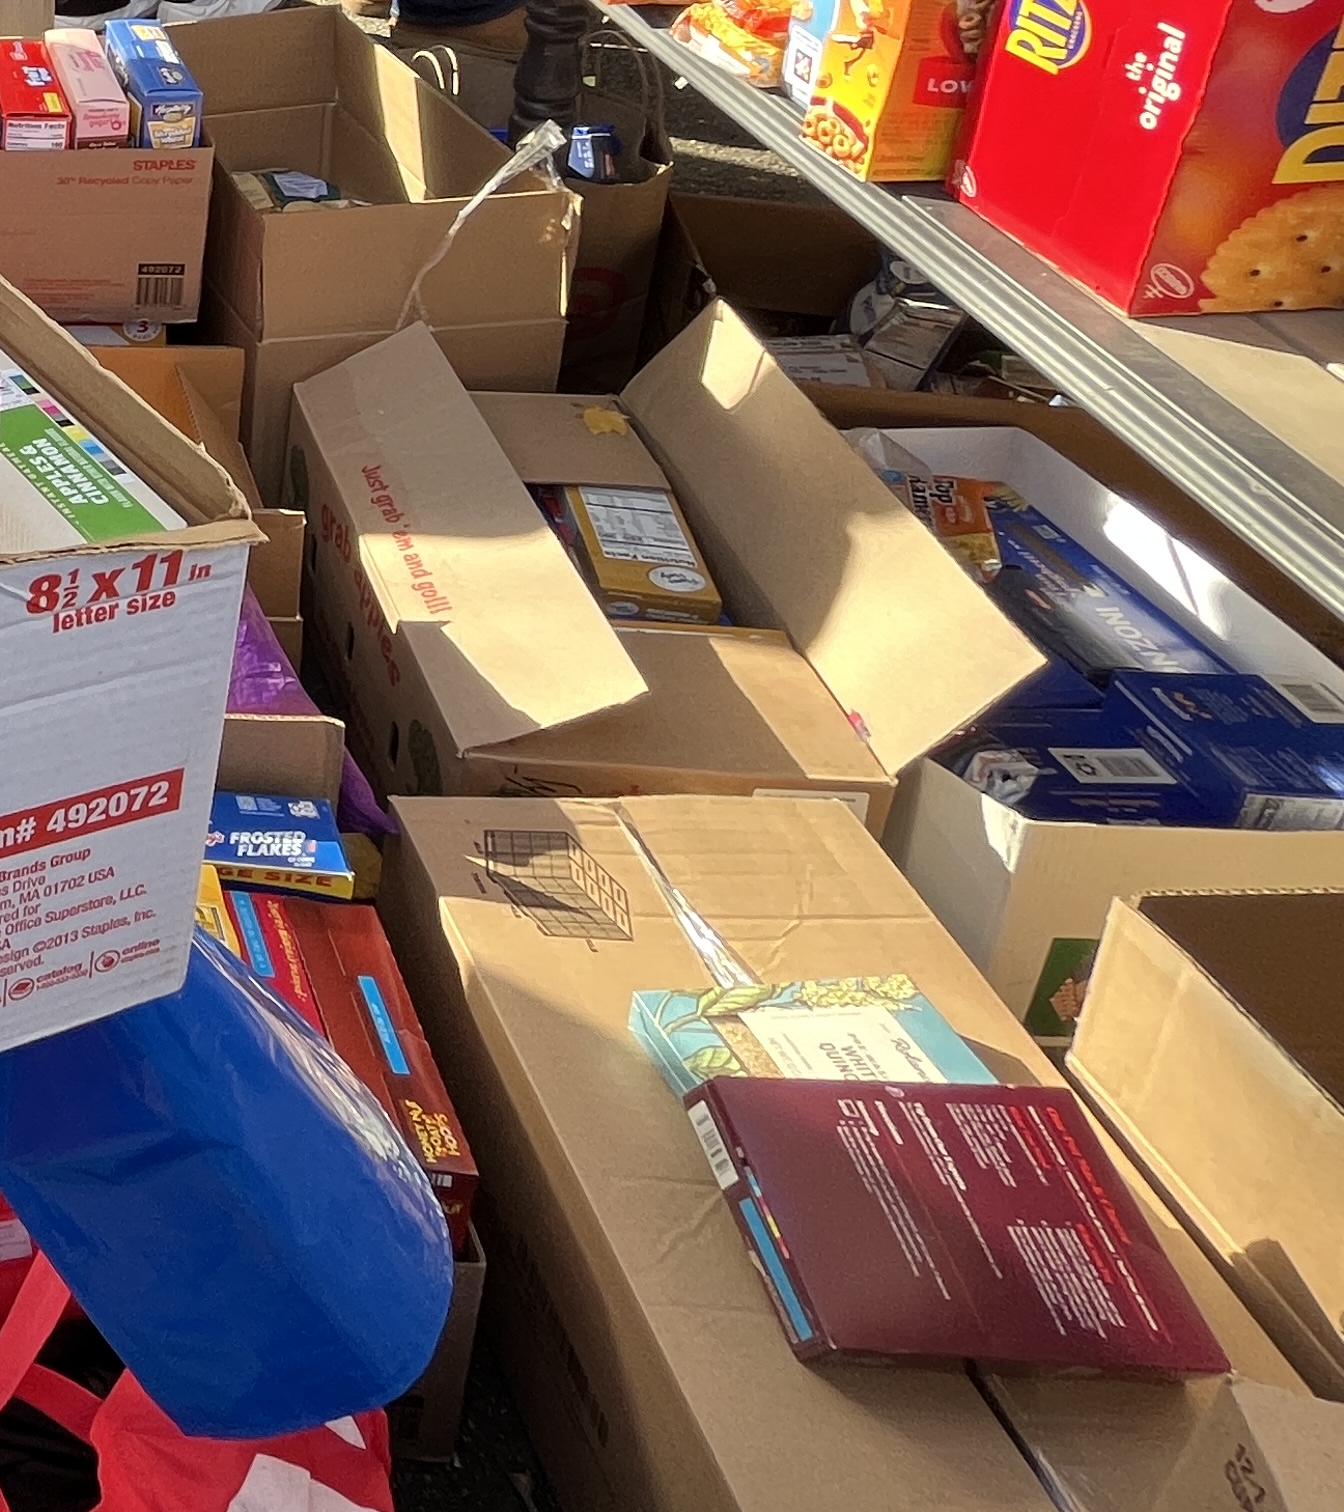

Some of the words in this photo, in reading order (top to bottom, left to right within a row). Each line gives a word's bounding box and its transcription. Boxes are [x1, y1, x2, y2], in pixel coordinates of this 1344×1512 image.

[1125, 52, 1148, 81] the
[1140, 22, 1187, 130] original
[133, 160, 196, 171] STAPLES
[30, 452, 89, 505] APPLES
[31, 437, 110, 505] CINNAMON
[362, 465, 389, 493] Just
[371, 487, 401, 524] grab
[132, 549, 183, 588] 11
[188, 563, 212, 583] in
[402, 553, 431, 579] and
[53, 600, 119, 634] letter
[127, 589, 176, 616] size
[46, 780, 170, 834] 492072
[229, 831, 307, 846] FROSTED
[237, 843, 303, 858] FLAKES
[50, 847, 91, 869] Group
[12, 874, 46, 894] Drive
[19, 887, 41, 905] MA
[43, 875, 85, 898] 01702
[88, 866, 115, 886] USA
[264, 871, 333, 888] SIZE
[5, 914, 42, 936] Office
[45, 893, 117, 925] Superstore,
[23, 901, 42, 917] for
[81, 915, 131, 942] Staples,
[134, 905, 157, 923] Inc.
